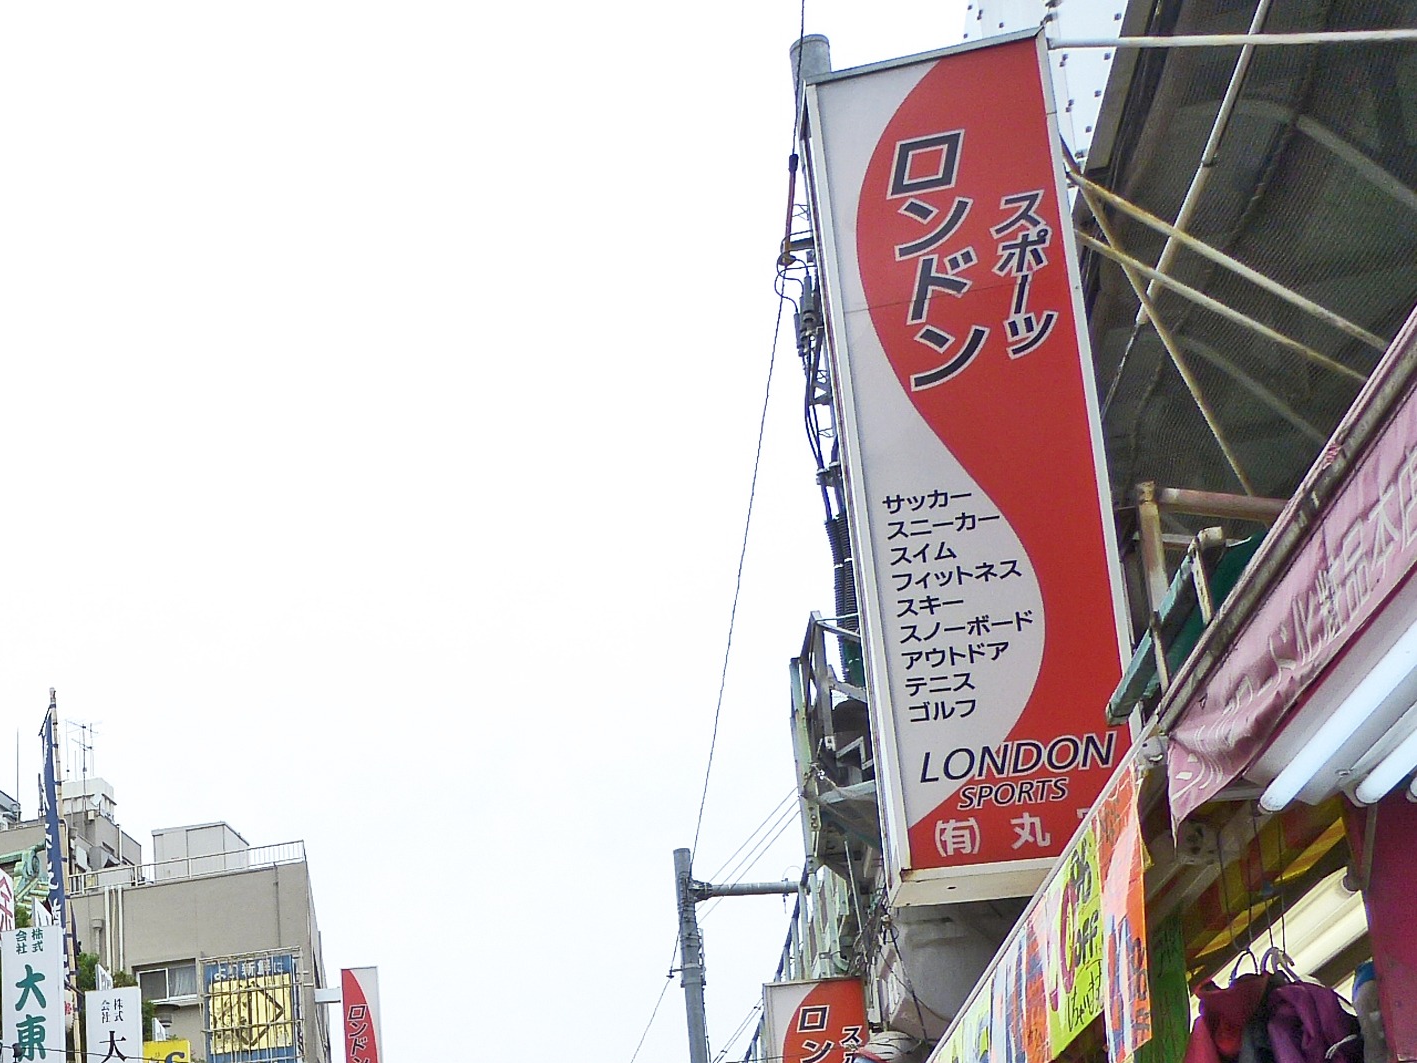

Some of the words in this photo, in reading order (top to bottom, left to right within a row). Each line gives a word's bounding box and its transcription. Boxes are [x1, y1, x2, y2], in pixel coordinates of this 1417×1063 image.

[888, 129, 988, 391] ロンドン
[989, 189, 1058, 361] スポーツ
[882, 489, 974, 512] サッカー
[886, 513, 1002, 540] スニーカー
[889, 541, 958, 565] スイム
[892, 558, 1023, 591] フィットネス
[895, 594, 964, 617] スキー
[899, 610, 1035, 645] スノーボード
[900, 638, 1011, 669] アウトドア
[904, 673, 977, 697] テニス
[908, 696, 978, 724] ゴルフ
[919, 731, 1118, 786] LONDON
[958, 775, 1070, 809] SPORTS
[15, 930, 28, 955] 会社
[31, 928, 44, 953] 株式
[1073, 908, 1100, 970] OFF
